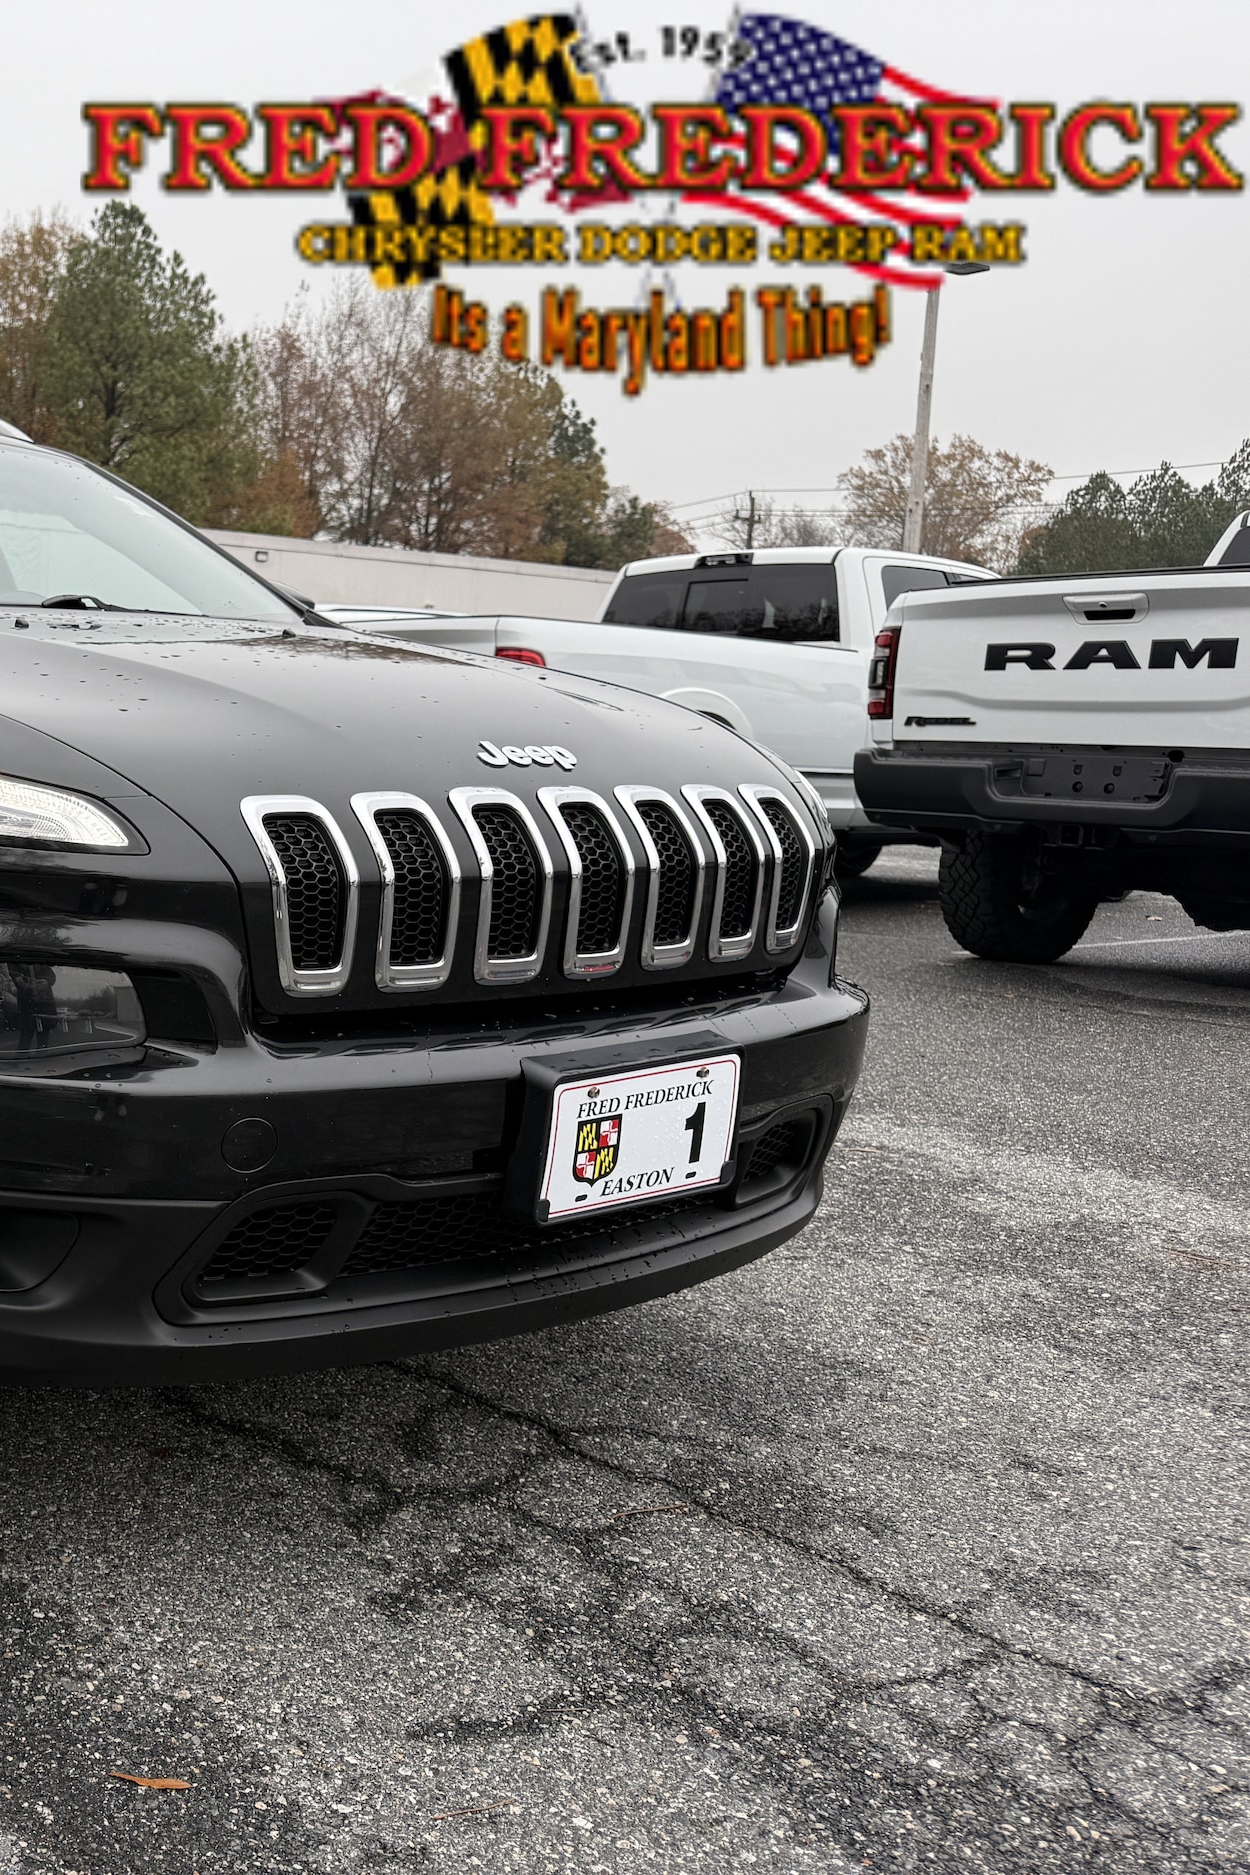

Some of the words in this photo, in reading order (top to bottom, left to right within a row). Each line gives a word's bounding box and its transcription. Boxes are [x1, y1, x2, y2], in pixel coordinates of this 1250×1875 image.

[984, 637, 1240, 671] RAM
[476, 741, 578, 771] Jeep
[576, 1097, 621, 1119] FRED
[623, 1080, 715, 1111] FREDERICK
[684, 1101, 706, 1164] 1
[600, 1167, 675, 1197] EASTON
